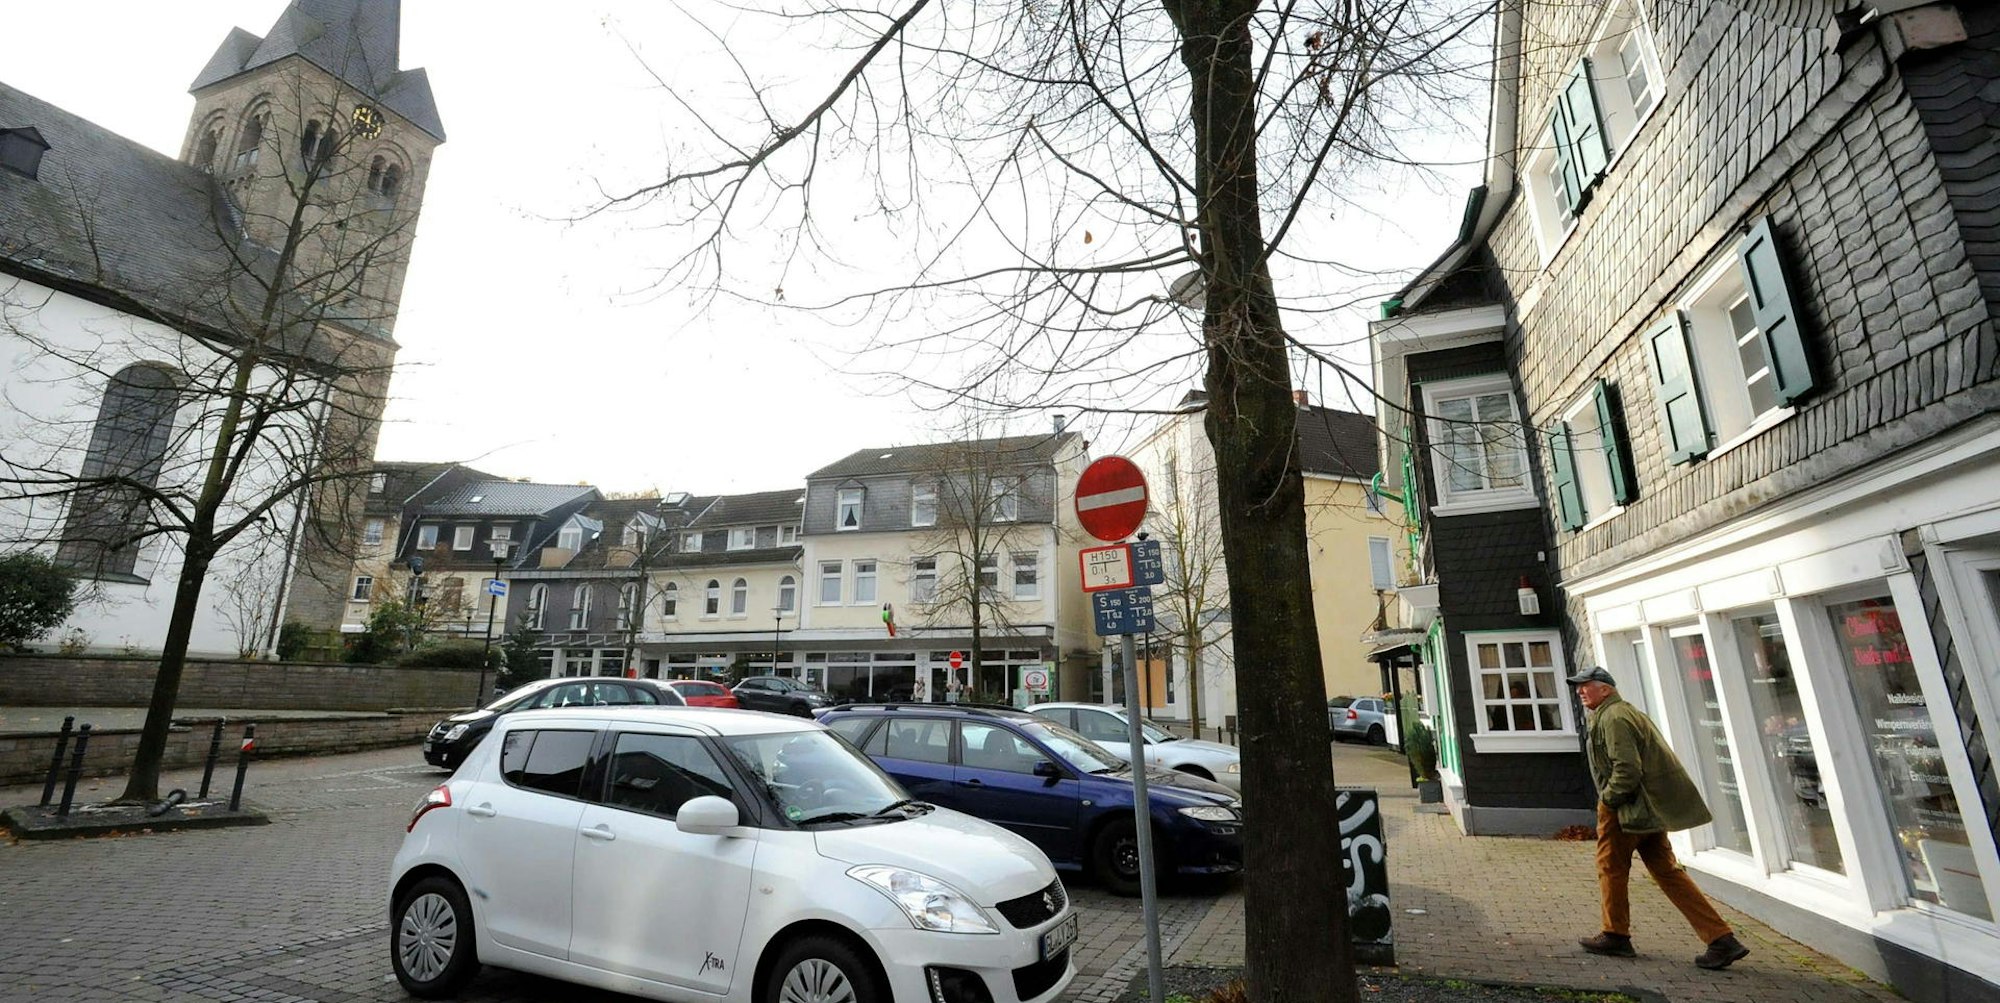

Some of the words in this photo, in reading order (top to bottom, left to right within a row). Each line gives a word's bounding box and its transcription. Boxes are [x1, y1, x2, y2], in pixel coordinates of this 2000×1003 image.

[1138, 547, 1145, 557] S
[1100, 597, 1107, 607] S
[1129, 594, 1136, 604] S
